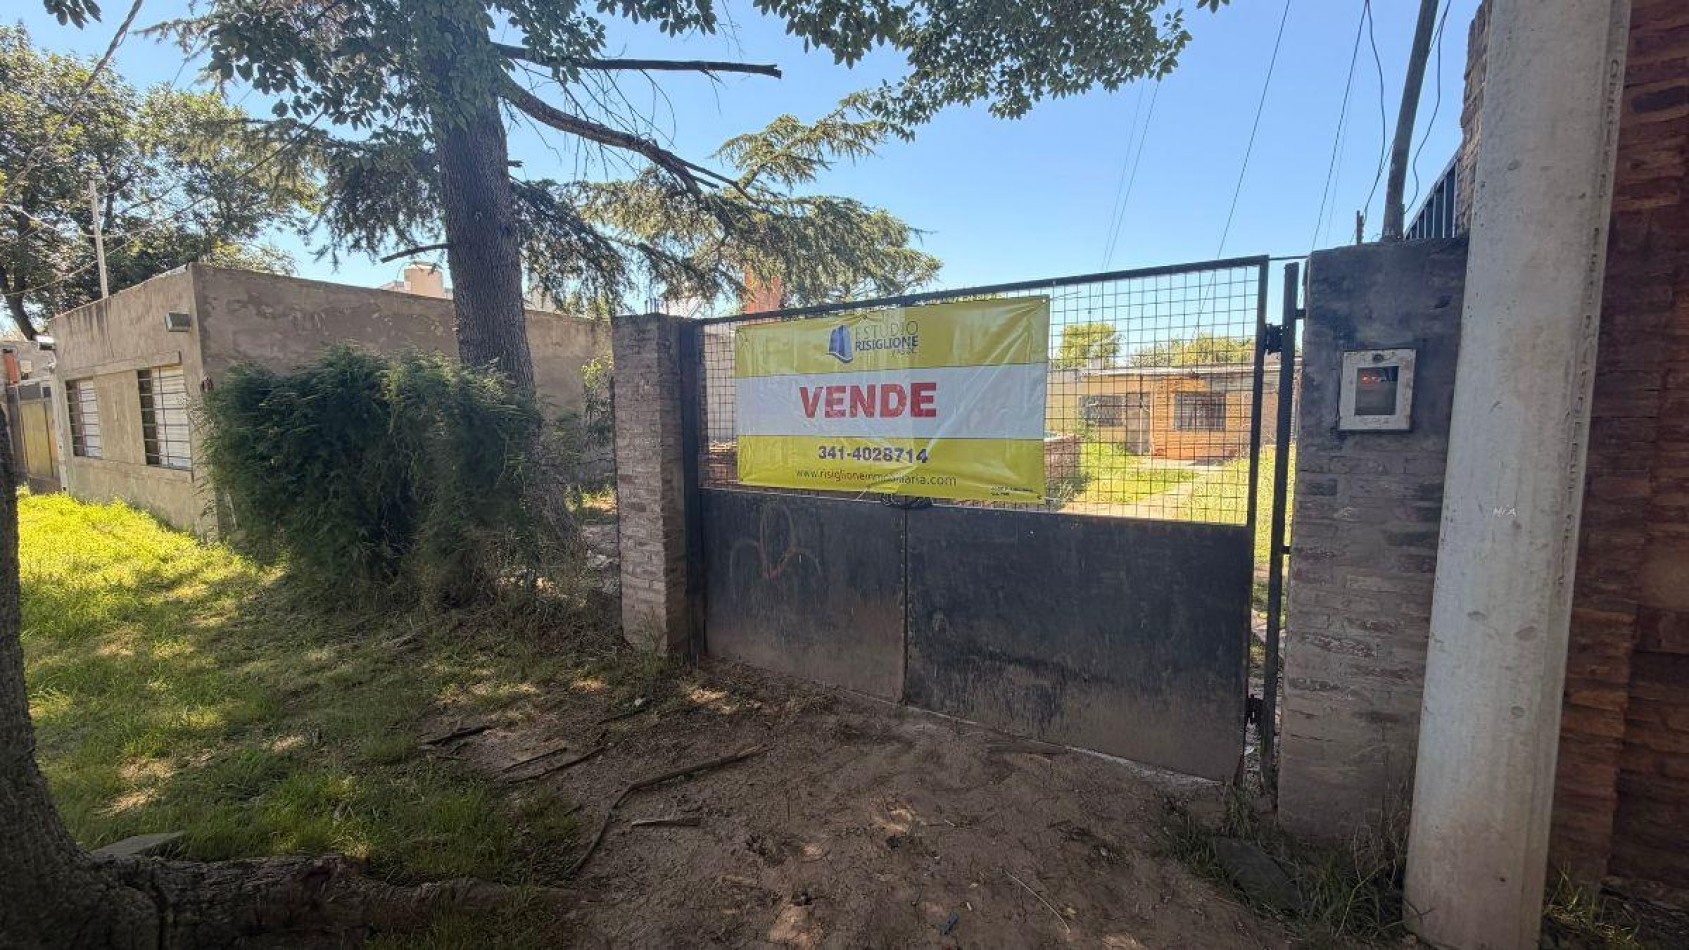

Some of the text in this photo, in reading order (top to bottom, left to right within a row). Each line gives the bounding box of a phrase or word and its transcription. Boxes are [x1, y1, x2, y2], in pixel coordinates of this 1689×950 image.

[855, 335, 919, 352] RISIGLIONE
[799, 382, 937, 418] VENDE
[818, 445, 929, 464] 341-4028714
